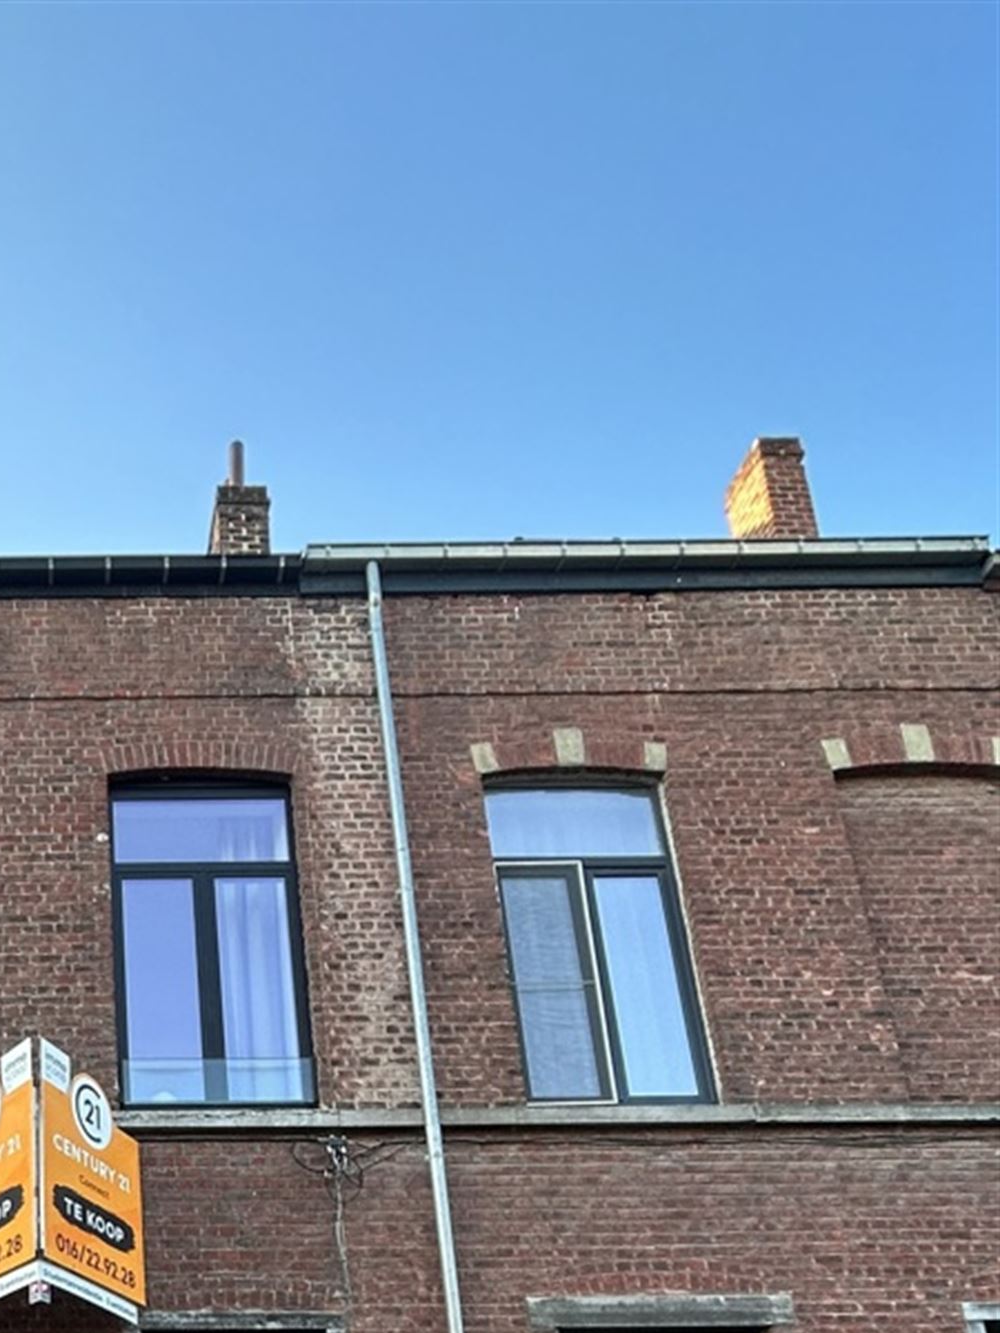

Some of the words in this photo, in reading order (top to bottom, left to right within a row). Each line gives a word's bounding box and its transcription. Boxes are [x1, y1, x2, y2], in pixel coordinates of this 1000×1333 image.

[7, 1133, 21, 1156] 21
[52, 1133, 116, 1184] CENTURY
[117, 1173, 130, 1194] 21
[63, 1196, 83, 1222] TE
[86, 1209, 124, 1243] KOOP
[55, 1233, 136, 1289] 016/22.92.28
